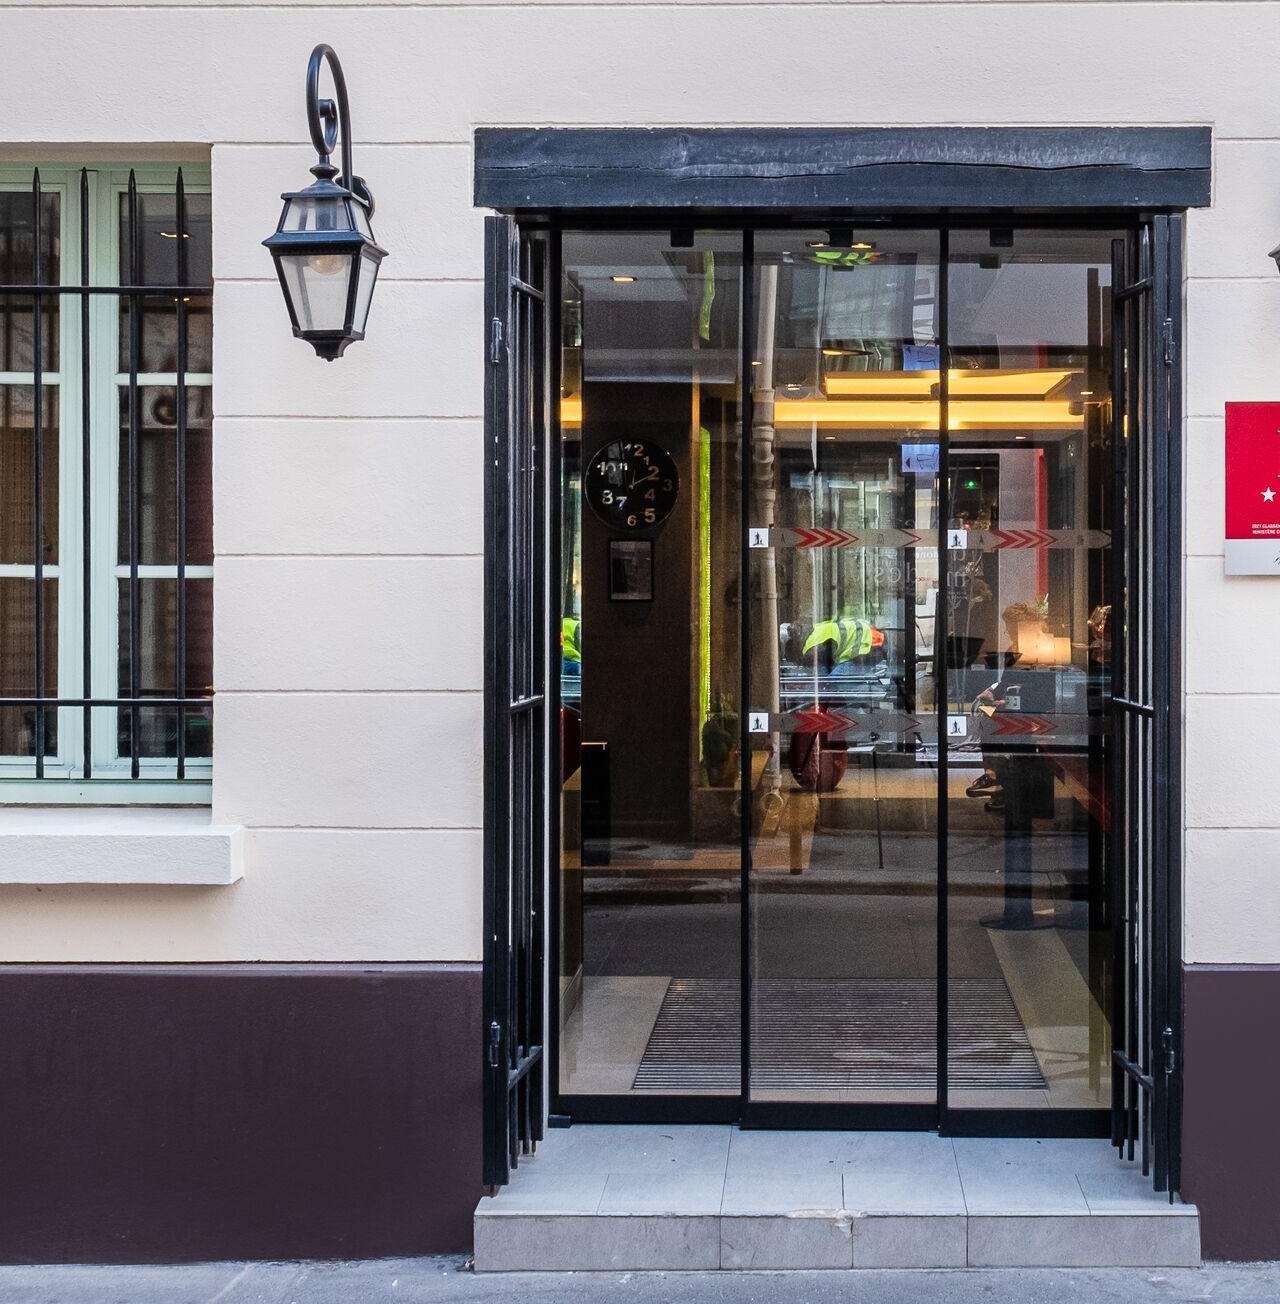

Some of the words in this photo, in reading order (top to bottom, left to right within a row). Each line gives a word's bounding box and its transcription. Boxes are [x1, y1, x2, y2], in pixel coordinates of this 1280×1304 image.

[624, 443, 644, 456] 12
[648, 465, 660, 481] 2
[602, 490, 613, 505] 8
[616, 496, 627, 511] 7
[627, 515, 637, 527] 6
[644, 508, 656, 523] 5
